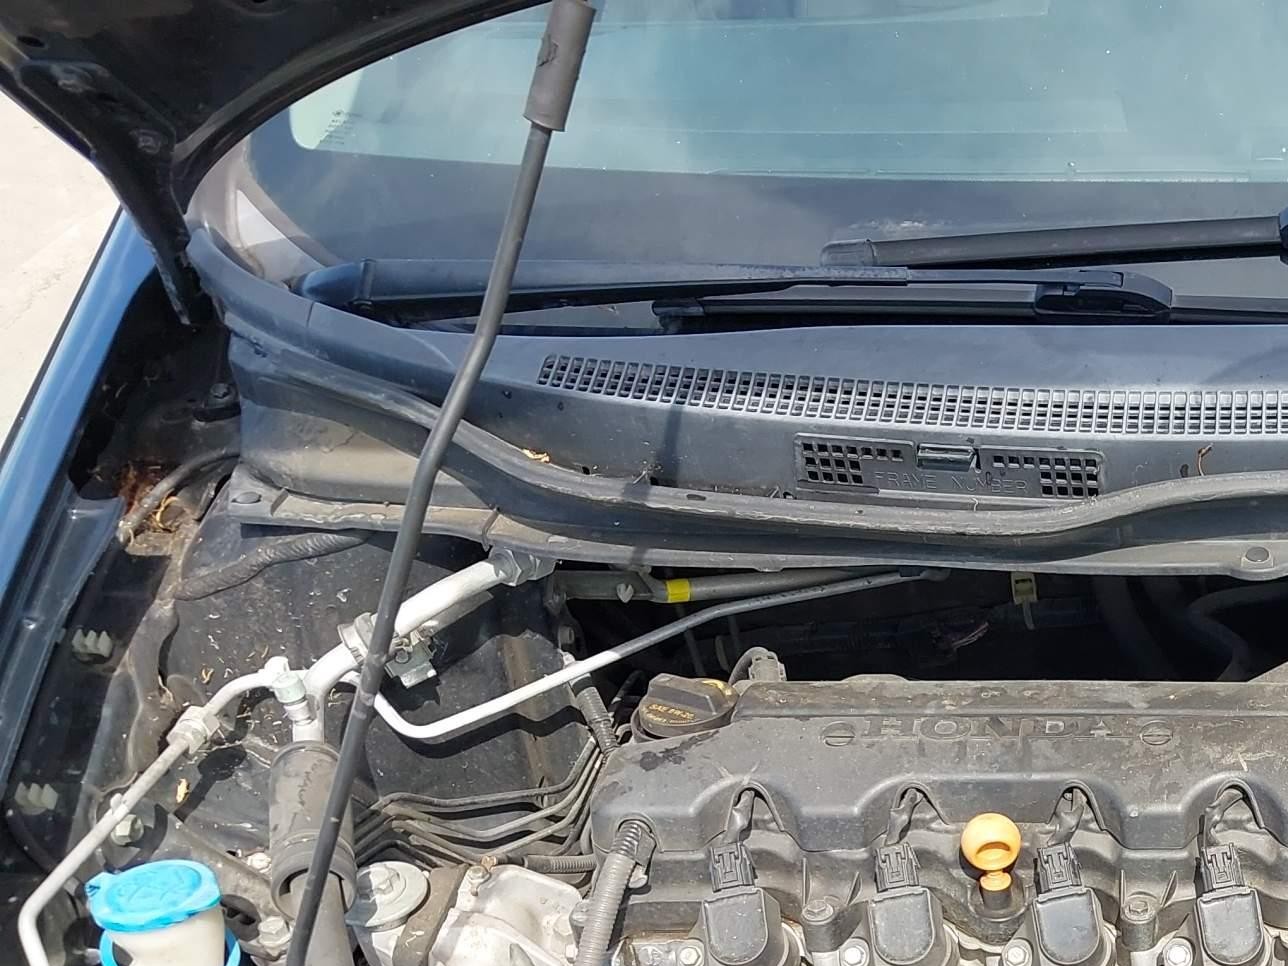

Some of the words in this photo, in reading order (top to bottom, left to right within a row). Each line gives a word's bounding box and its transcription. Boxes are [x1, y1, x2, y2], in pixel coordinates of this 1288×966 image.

[874, 471, 937, 490] FRAME
[951, 475, 1028, 494] NUMBER
[860, 716, 1136, 740] HONDA
